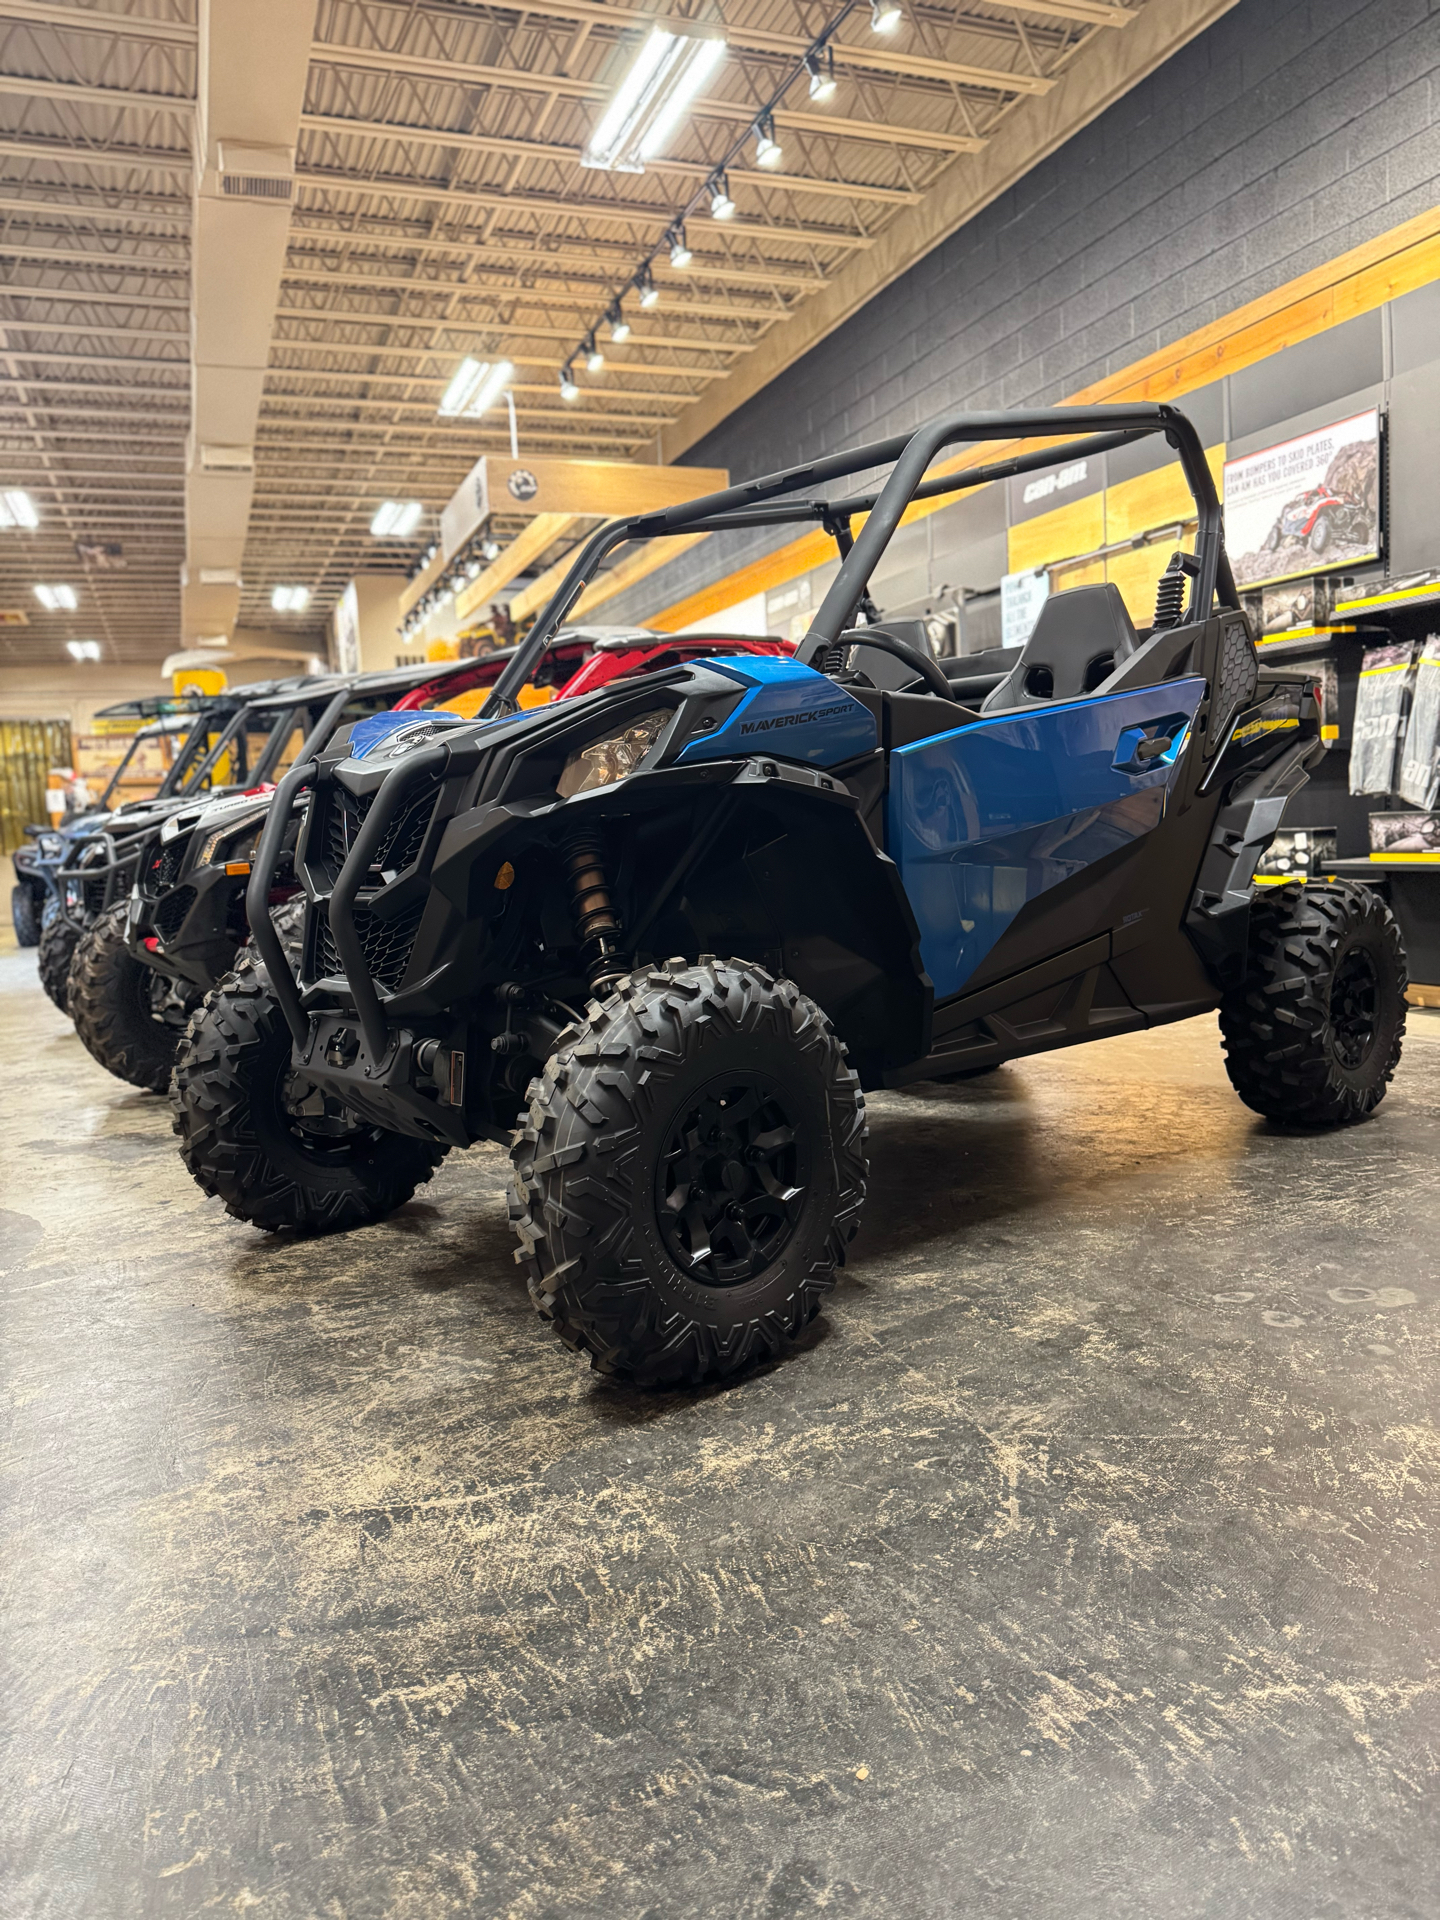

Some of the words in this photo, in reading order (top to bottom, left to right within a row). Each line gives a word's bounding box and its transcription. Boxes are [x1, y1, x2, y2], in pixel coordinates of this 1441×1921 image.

[1246, 458, 1277, 478] BUMPERS
[1278, 454, 1287, 467] TO
[1253, 474, 1266, 488] HAS
[1268, 469, 1281, 484] YOU
[1283, 458, 1314, 478] COVERED
[740, 711, 818, 735] MAVERICK
[817, 704, 855, 718] SPORT
[213, 799, 248, 812] TURBO
